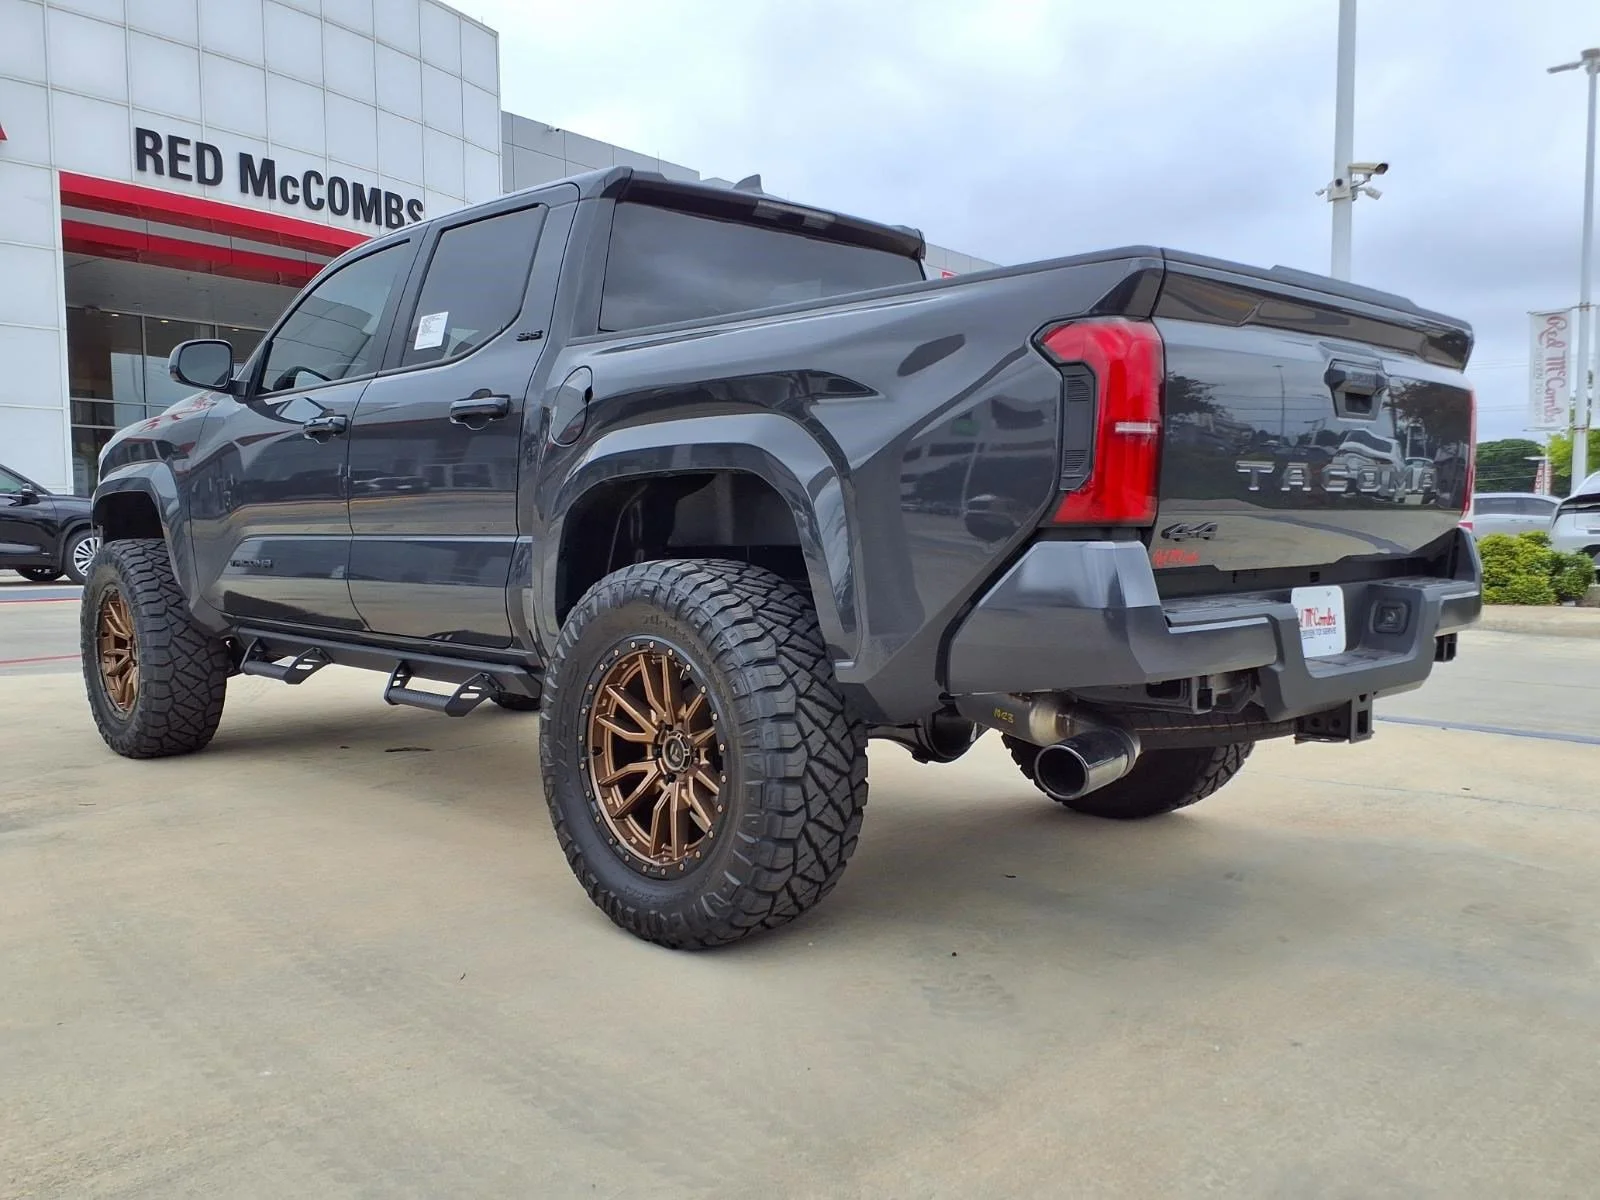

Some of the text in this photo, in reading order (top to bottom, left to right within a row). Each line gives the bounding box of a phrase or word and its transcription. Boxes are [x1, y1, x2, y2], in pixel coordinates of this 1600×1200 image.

[135, 127, 424, 229] RED McCOMBS
[1538, 315, 1568, 349] Red
[1235, 460, 1440, 494] TACOMA
